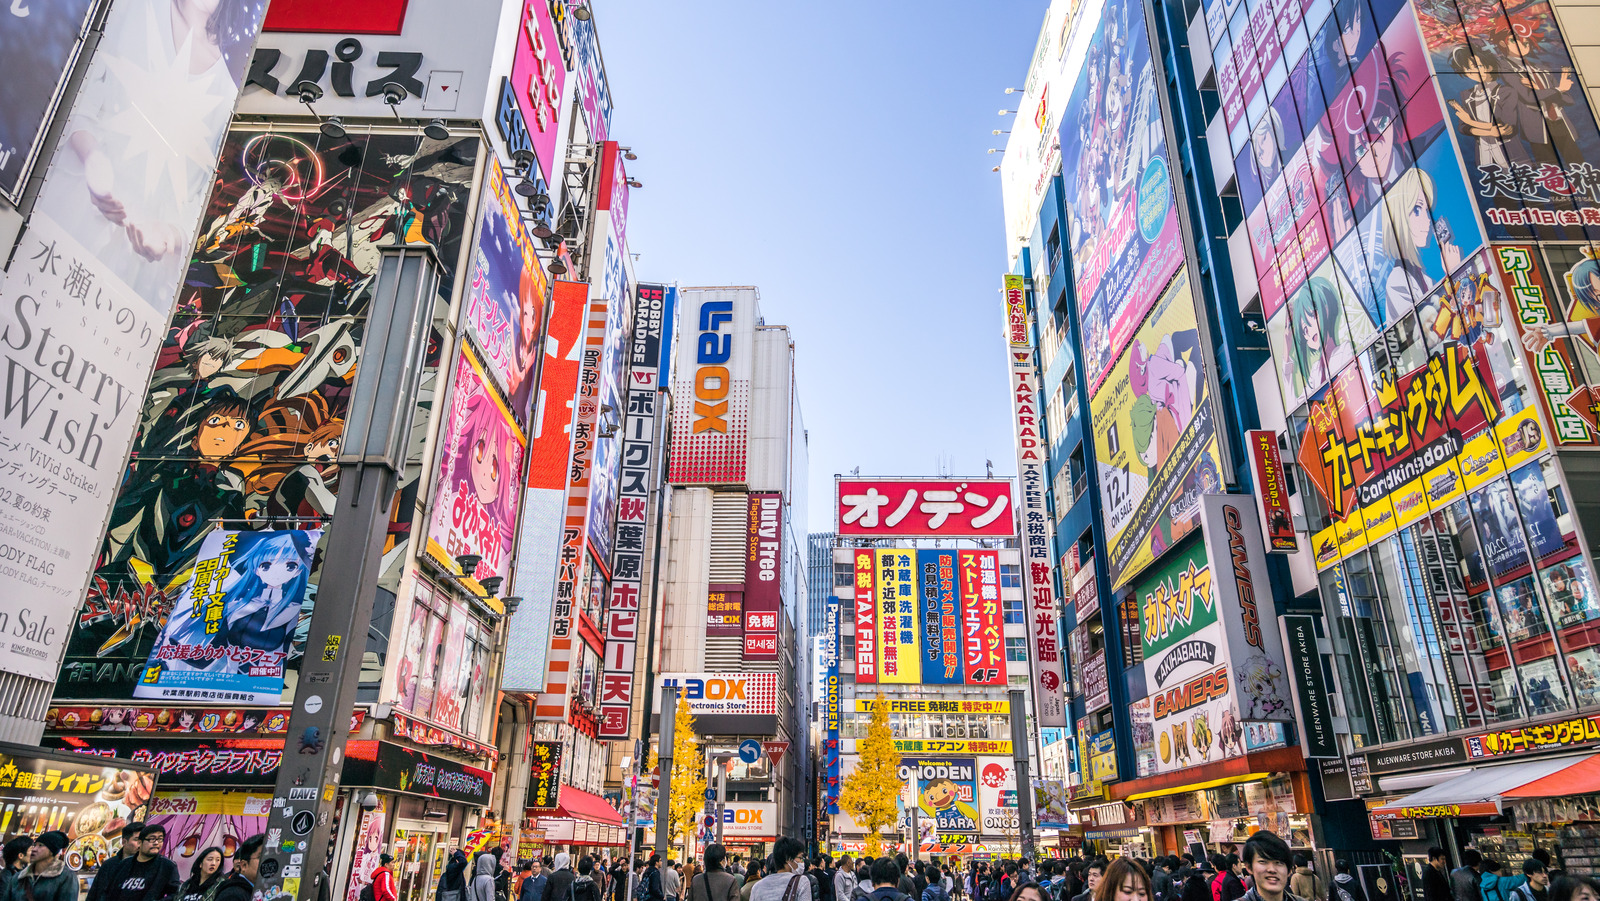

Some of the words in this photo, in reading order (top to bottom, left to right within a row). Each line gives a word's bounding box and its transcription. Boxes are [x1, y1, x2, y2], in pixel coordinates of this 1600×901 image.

[30, 240, 153, 349] 水瀬いのり
[649, 289, 662, 339] HOBBY
[1006, 287, 1027, 343] まんが喫茶
[24, 272, 63, 309] New
[79, 315, 142, 370] Single
[632, 288, 651, 364] PARADISE
[1, 294, 134, 430] Starry
[4, 354, 102, 471] Wish
[1014, 372, 1039, 460] TAKARADA
[1106, 462, 1130, 513] 12.7
[1260, 442, 1281, 507] カードキングダム
[749, 498, 760, 534] Flagship
[758, 498, 780, 538] Duty
[841, 483, 1008, 529] オノデン
[26, 555, 55, 576] FLAG
[749, 536, 759, 562] Store
[759, 541, 779, 582] Free
[205, 533, 238, 635] スニーカー文庫は
[552, 529, 578, 637] アキバ駅前店
[857, 554, 872, 588] 免税
[1222, 503, 1265, 655] GAMERS
[709, 593, 726, 602] 本店
[857, 591, 873, 624] TAX
[924, 563, 940, 660] お見積り無料です
[938, 555, 958, 678] 防犯カメラ販売開始!!
[13, 608, 55, 646] Sale
[748, 614, 775, 628] 免税
[828, 603, 839, 668] Panasonic
[1296, 625, 1307, 654] AKIBA
[155, 646, 287, 665] 応援ありがとうフェア
[747, 639, 775, 650] 면세점
[858, 628, 874, 676] FREE
[1159, 643, 1210, 680] AKIHABARA
[250, 667, 281, 677] 開催中!!
[970, 668, 998, 682] 4F
[1302, 656, 1314, 687] STORE
[726, 702, 747, 710] Store
[828, 675, 838, 730] ONODEN
[892, 702, 925, 711] FREE
[928, 701, 959, 711] 免税店
[1154, 665, 1230, 721] GAMERS
[1308, 689, 1326, 747] ALIENWARE
[893, 741, 924, 752] 冷蔵庫
[927, 742, 965, 752] エアコン
[967, 741, 1008, 753] 特売中!!
[1377, 753, 1411, 766] ALIENWARE
[1412, 750, 1433, 762] STORE
[1435, 747, 1456, 758] AKIBA
[15, 768, 105, 794] 銀座ライオン
[828, 738, 838, 804] オノデン
[289, 788, 316, 799] DAVE
